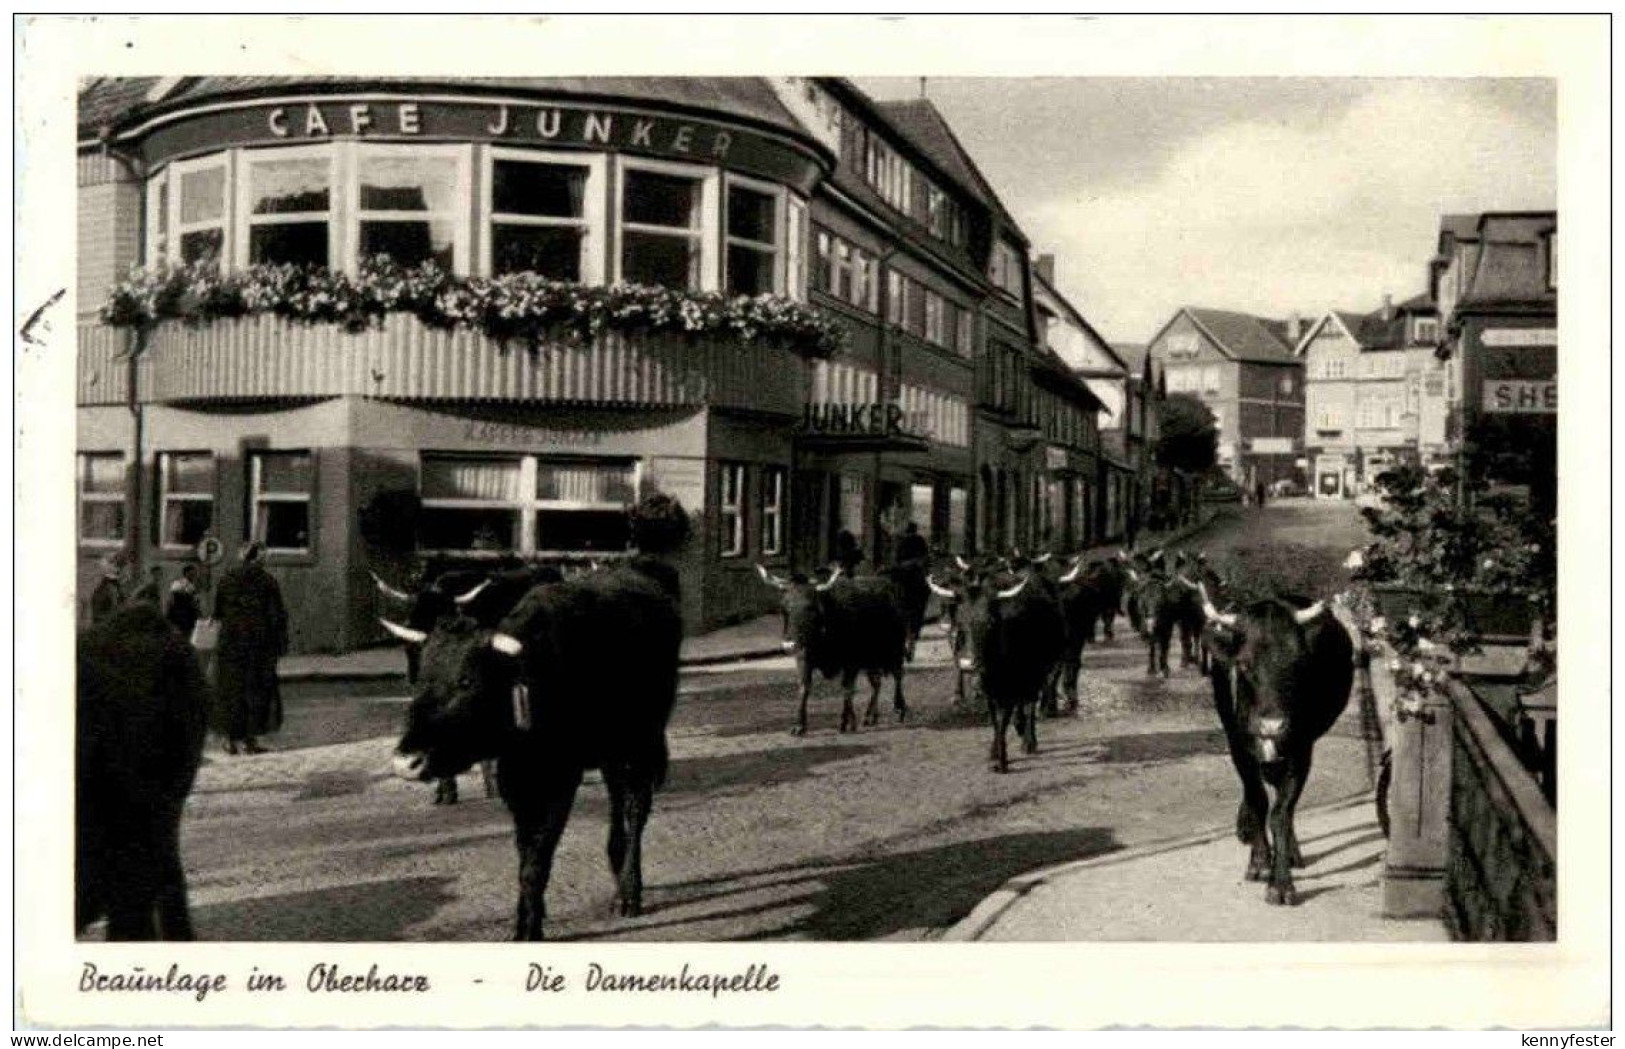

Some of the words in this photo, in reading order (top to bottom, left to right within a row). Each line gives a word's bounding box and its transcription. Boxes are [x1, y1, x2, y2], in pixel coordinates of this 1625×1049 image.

[268, 101, 419, 137] CAFE
[486, 104, 732, 158] JUNKER
[800, 402, 903, 434] JUNKER
